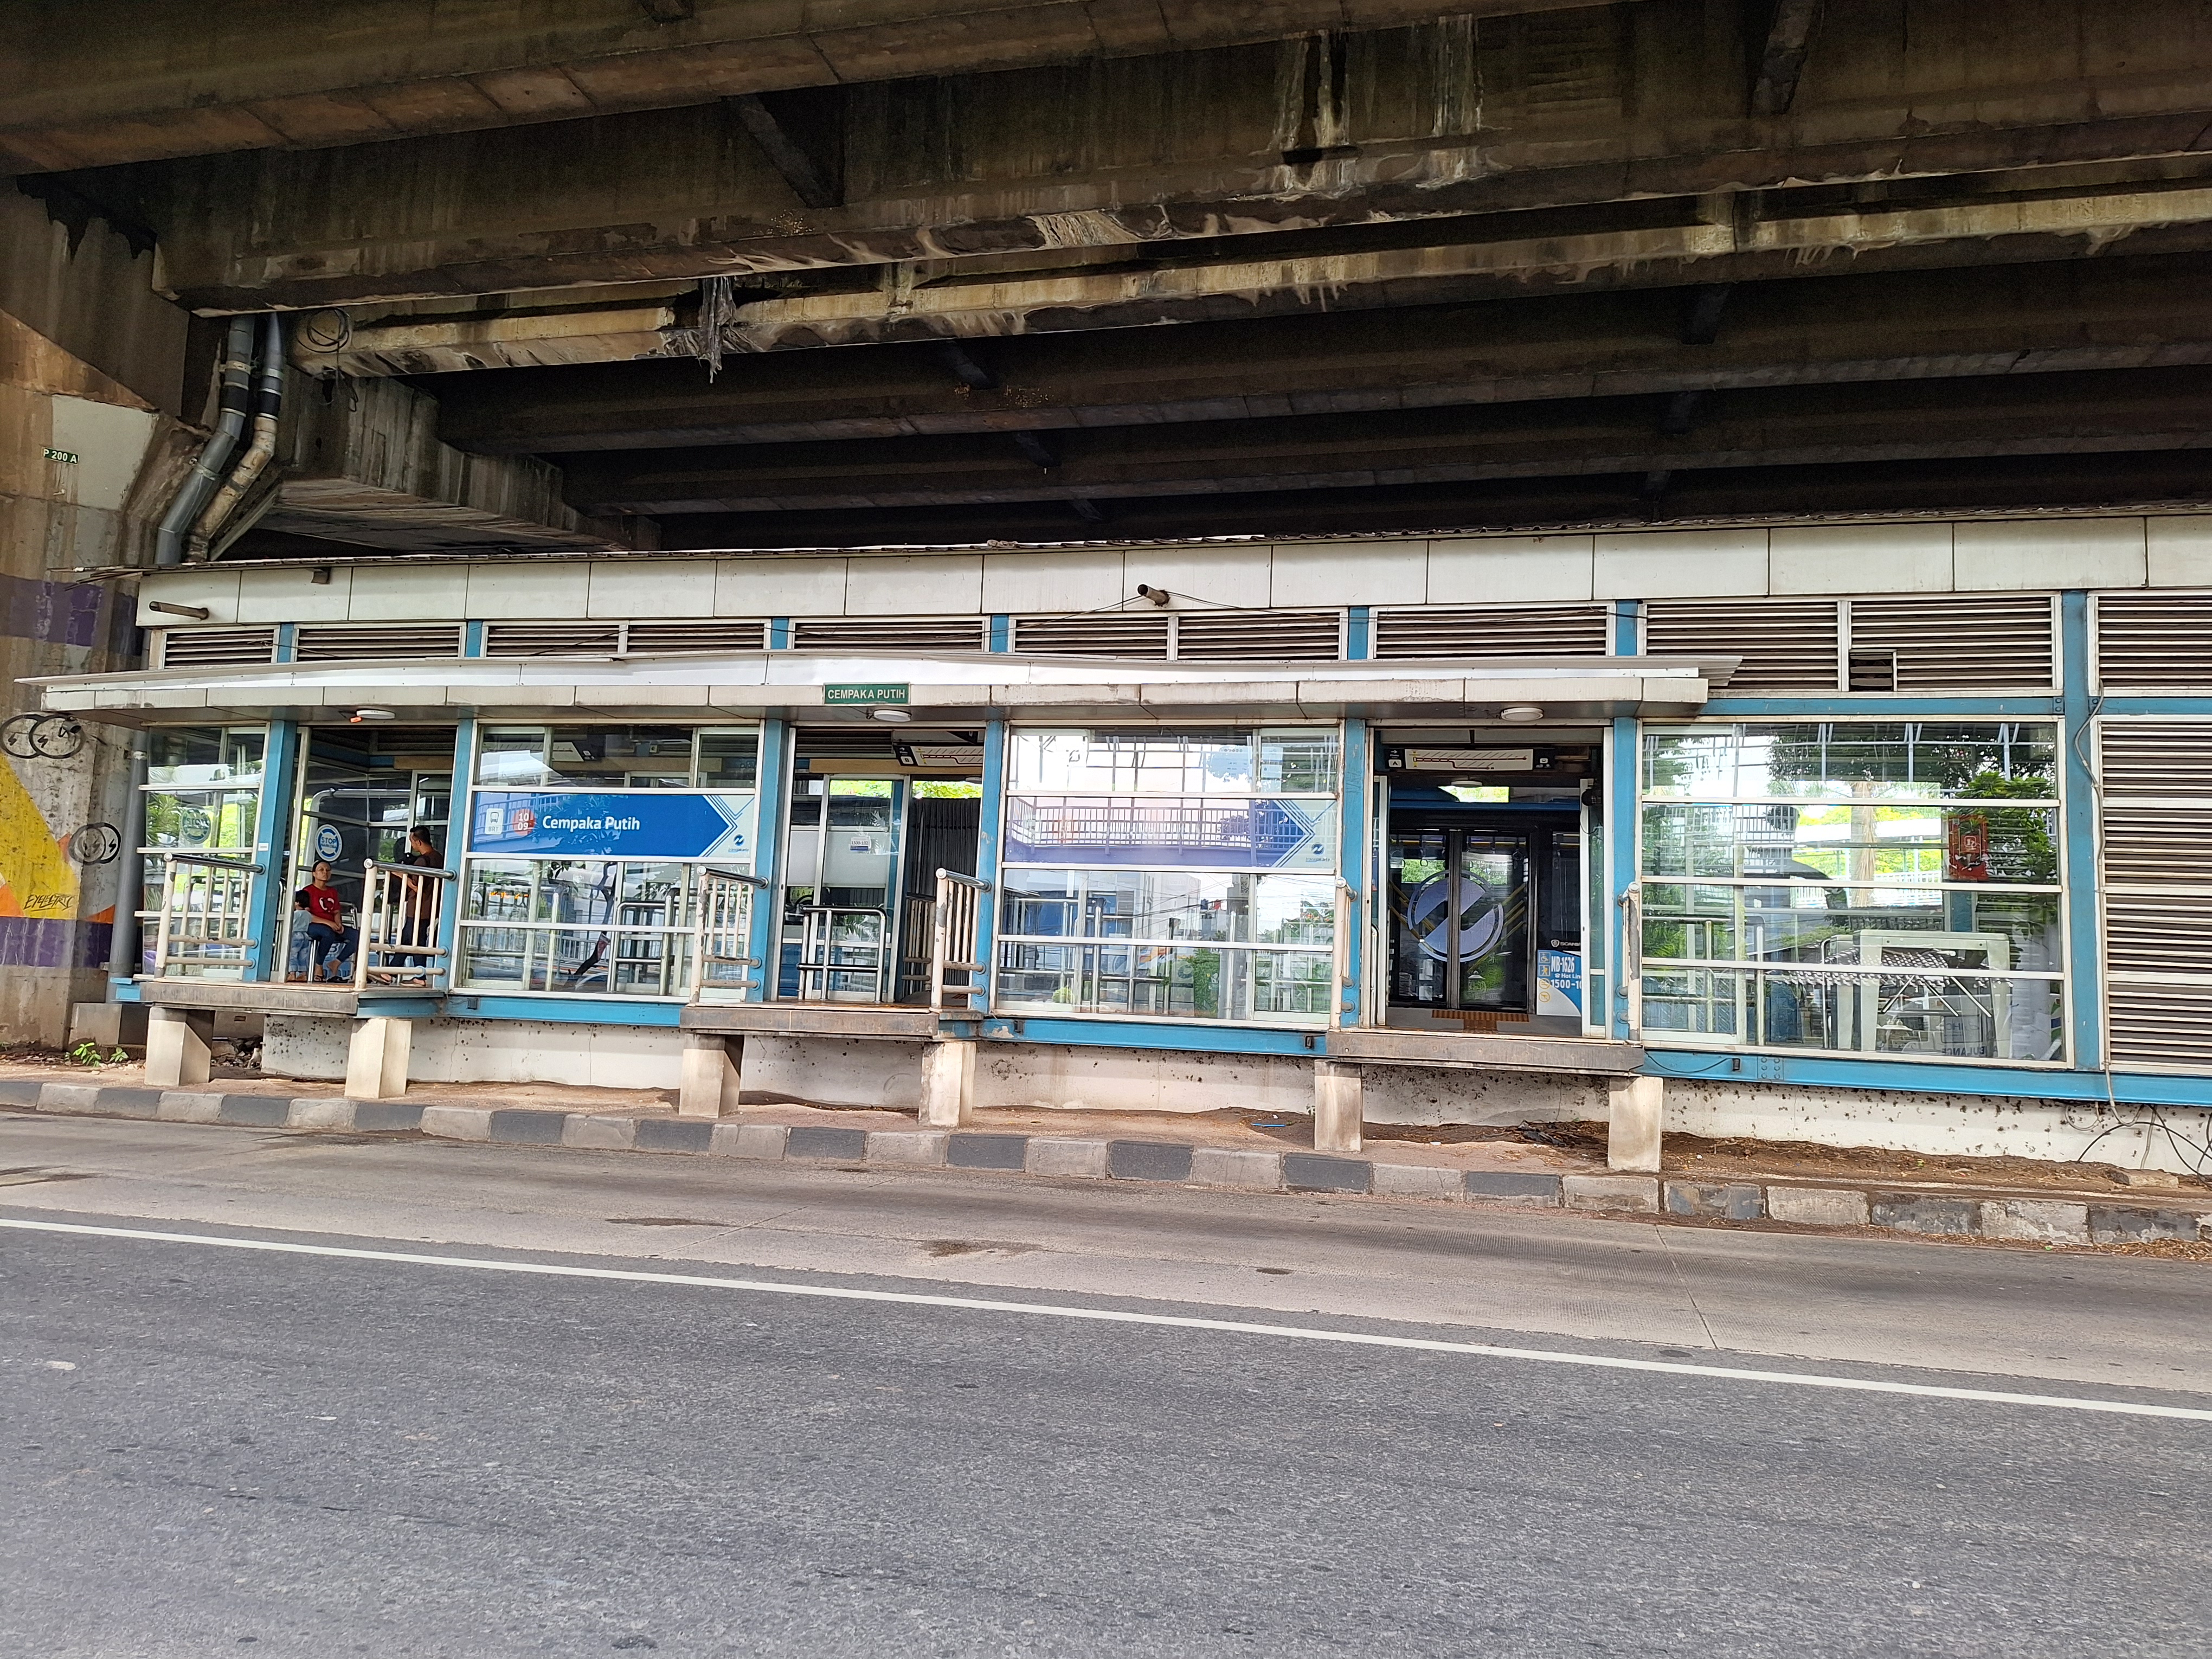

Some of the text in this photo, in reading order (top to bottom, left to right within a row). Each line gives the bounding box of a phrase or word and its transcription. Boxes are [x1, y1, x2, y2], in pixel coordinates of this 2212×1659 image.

[43, 448, 77, 464] P 200 A
[828, 689, 905, 699] CEMPAKA PUTIH
[519, 813, 529, 821] 10
[543, 815, 640, 832] Cempaka Putih
[518, 822, 529, 831] 09
[1551, 956, 1575, 973] MB-1626
